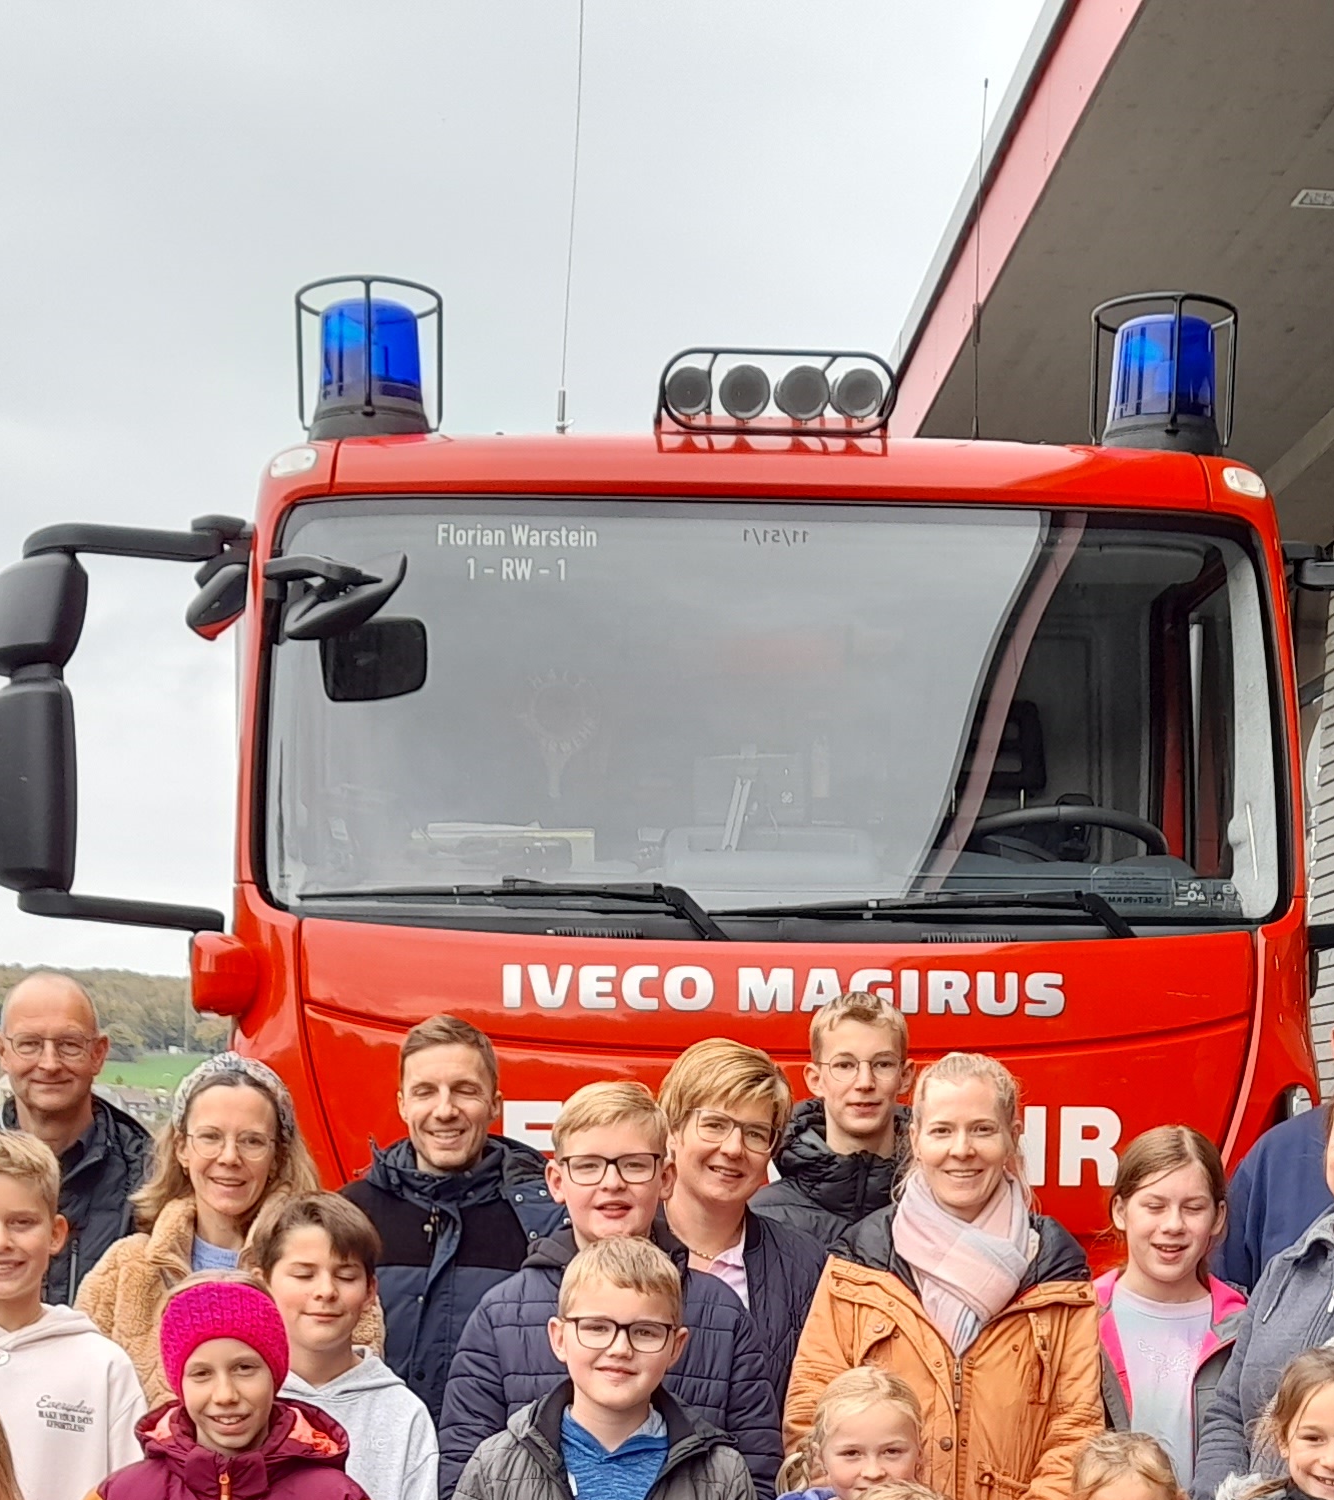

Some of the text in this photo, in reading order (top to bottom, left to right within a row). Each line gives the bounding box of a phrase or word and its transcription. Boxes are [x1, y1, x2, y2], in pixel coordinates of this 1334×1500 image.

[436, 523, 598, 547] Florian Warstein
[467, 557, 476, 580] 1
[501, 558, 533, 581] RW
[557, 558, 566, 581] 1
[501, 963, 1066, 1017] IVECO MAGIRUS
